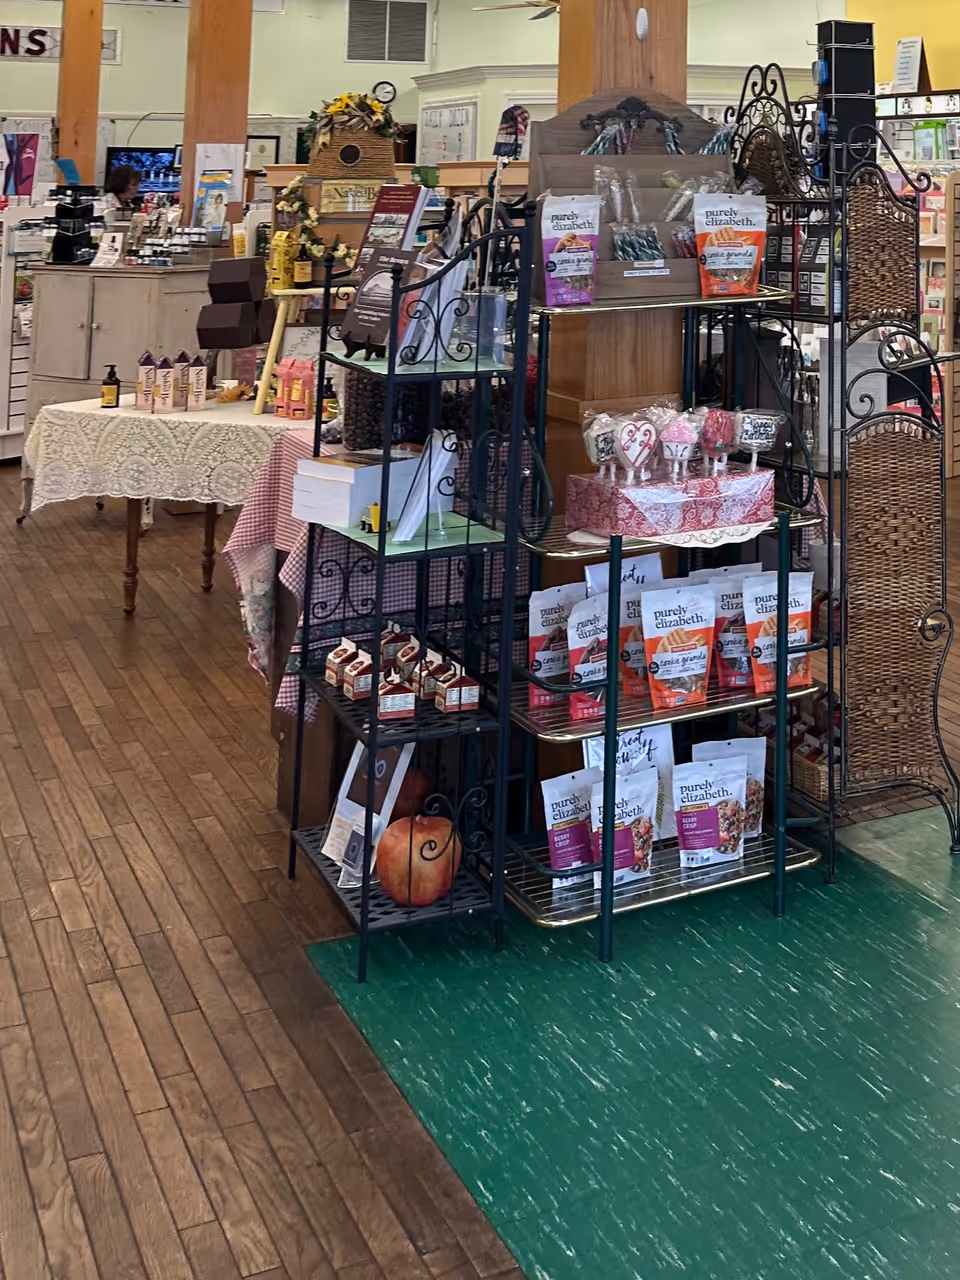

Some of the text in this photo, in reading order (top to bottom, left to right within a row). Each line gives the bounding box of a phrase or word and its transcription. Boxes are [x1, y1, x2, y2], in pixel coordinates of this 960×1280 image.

[550, 210, 579, 224] purely
[704, 208, 740, 220] purely
[704, 216, 757, 227] elizabeth.
[725, 248, 753, 261] granola
[540, 604, 565, 620] purely
[653, 605, 689, 621] purely
[575, 614, 602, 632] purely
[655, 613, 708, 629] elizabeth.
[542, 655, 560, 665] cookie
[660, 651, 706, 667] cookie granola
[582, 667, 601, 677] cookie
[680, 779, 714, 795] purely
[681, 786, 733, 803] elizabeth.
[551, 793, 580, 813] purely
[682, 816, 698, 824] BERRY
[554, 833, 570, 843] BERRY
[555, 839, 570, 848] CRISP
